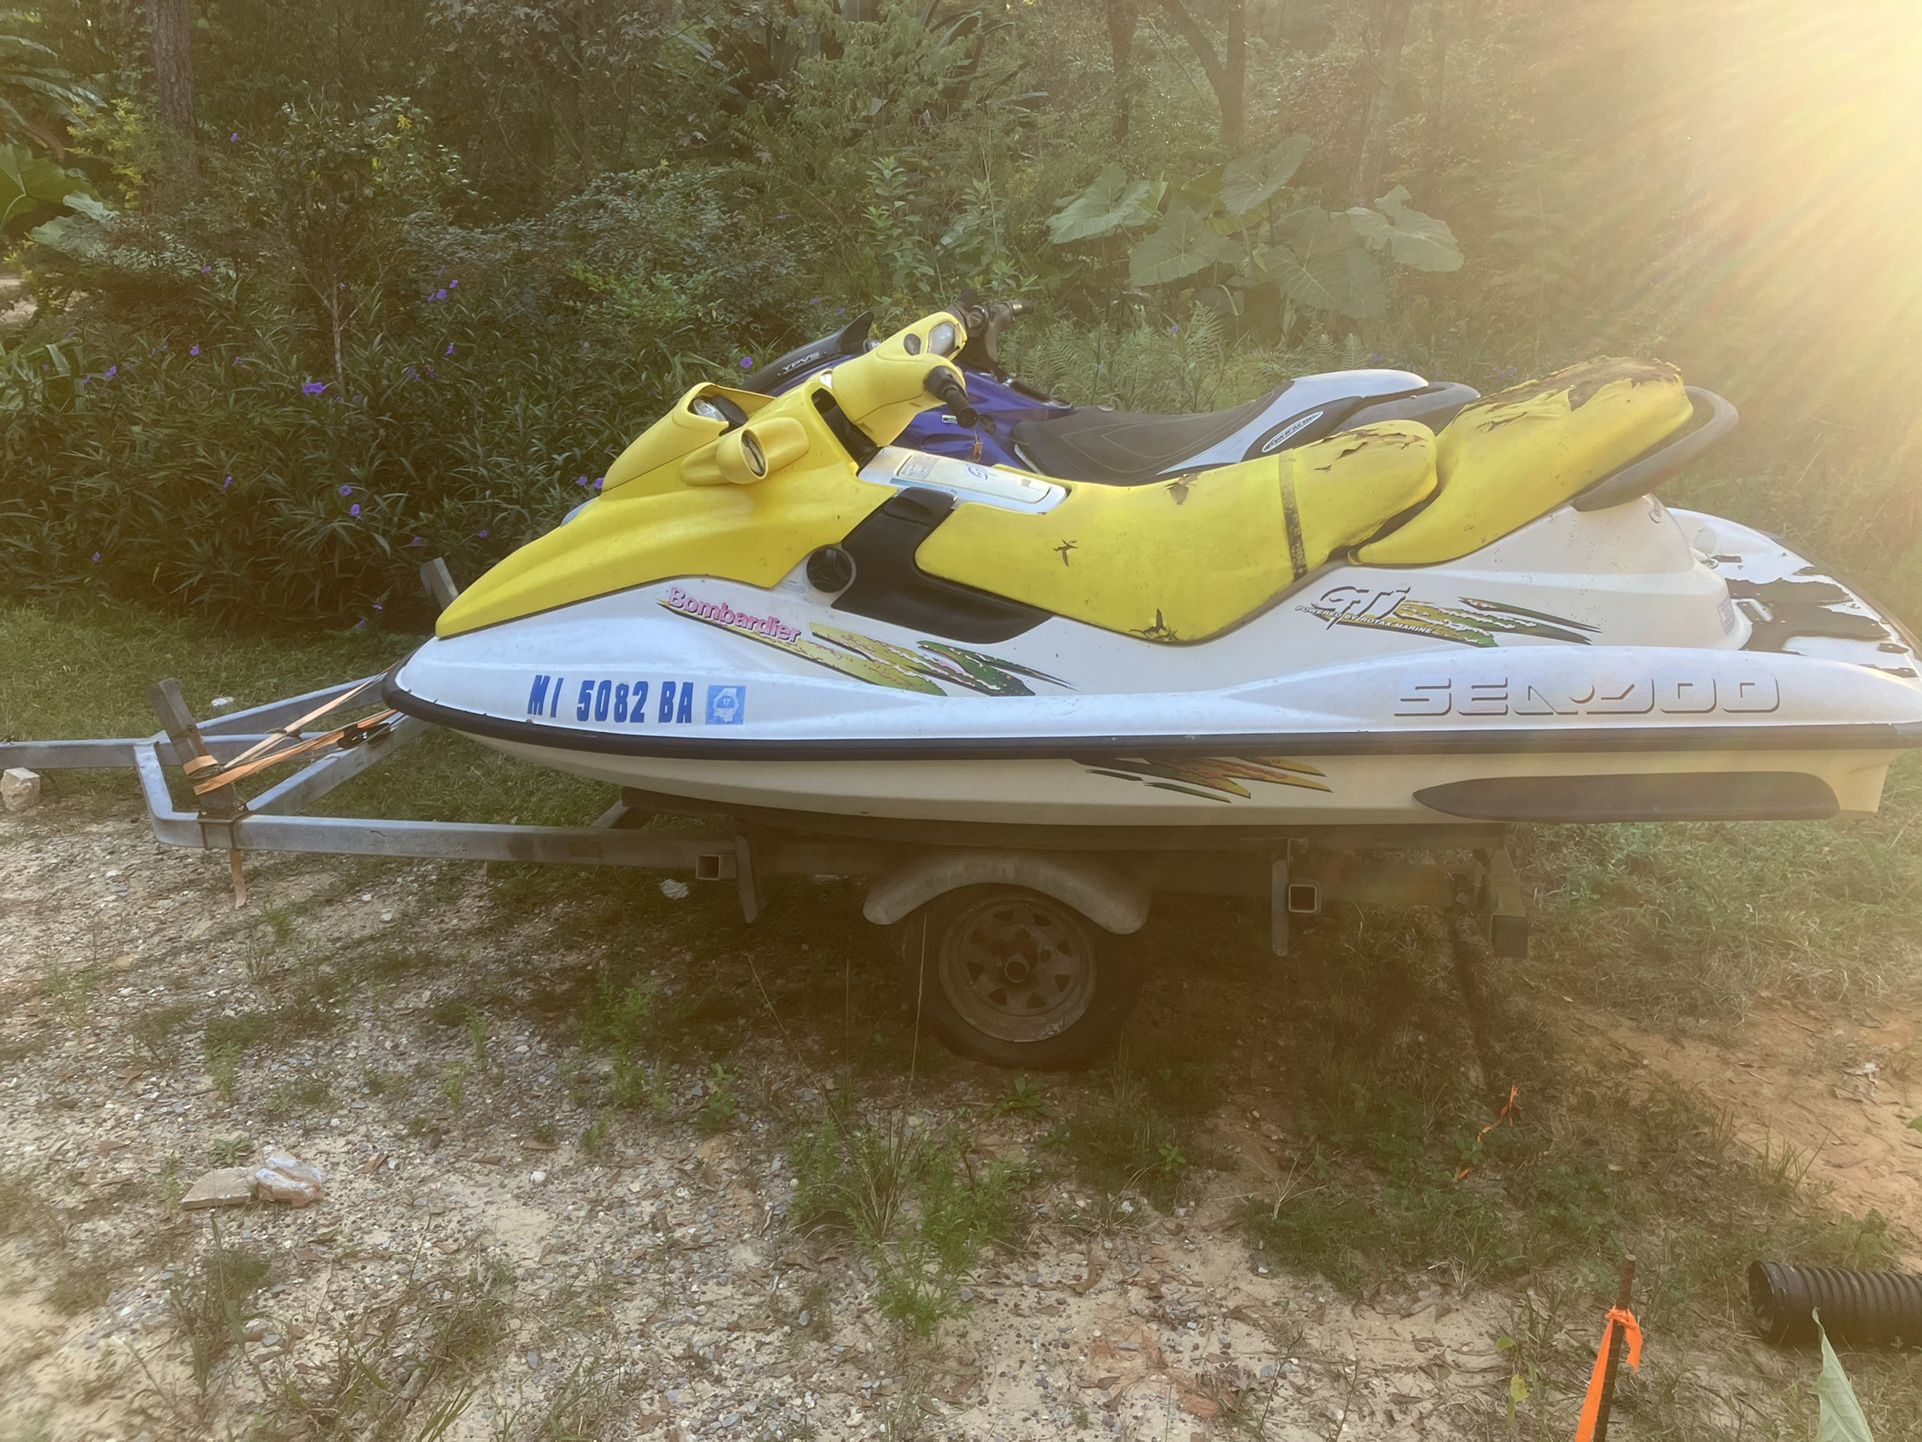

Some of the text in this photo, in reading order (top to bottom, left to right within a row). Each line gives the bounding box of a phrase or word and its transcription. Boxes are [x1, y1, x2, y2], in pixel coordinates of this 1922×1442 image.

[668, 586, 801, 643] Bombardier
[1294, 605, 1433, 634] POWERED BY ROTAX MARINE
[527, 674, 694, 724] MI 5082 BA
